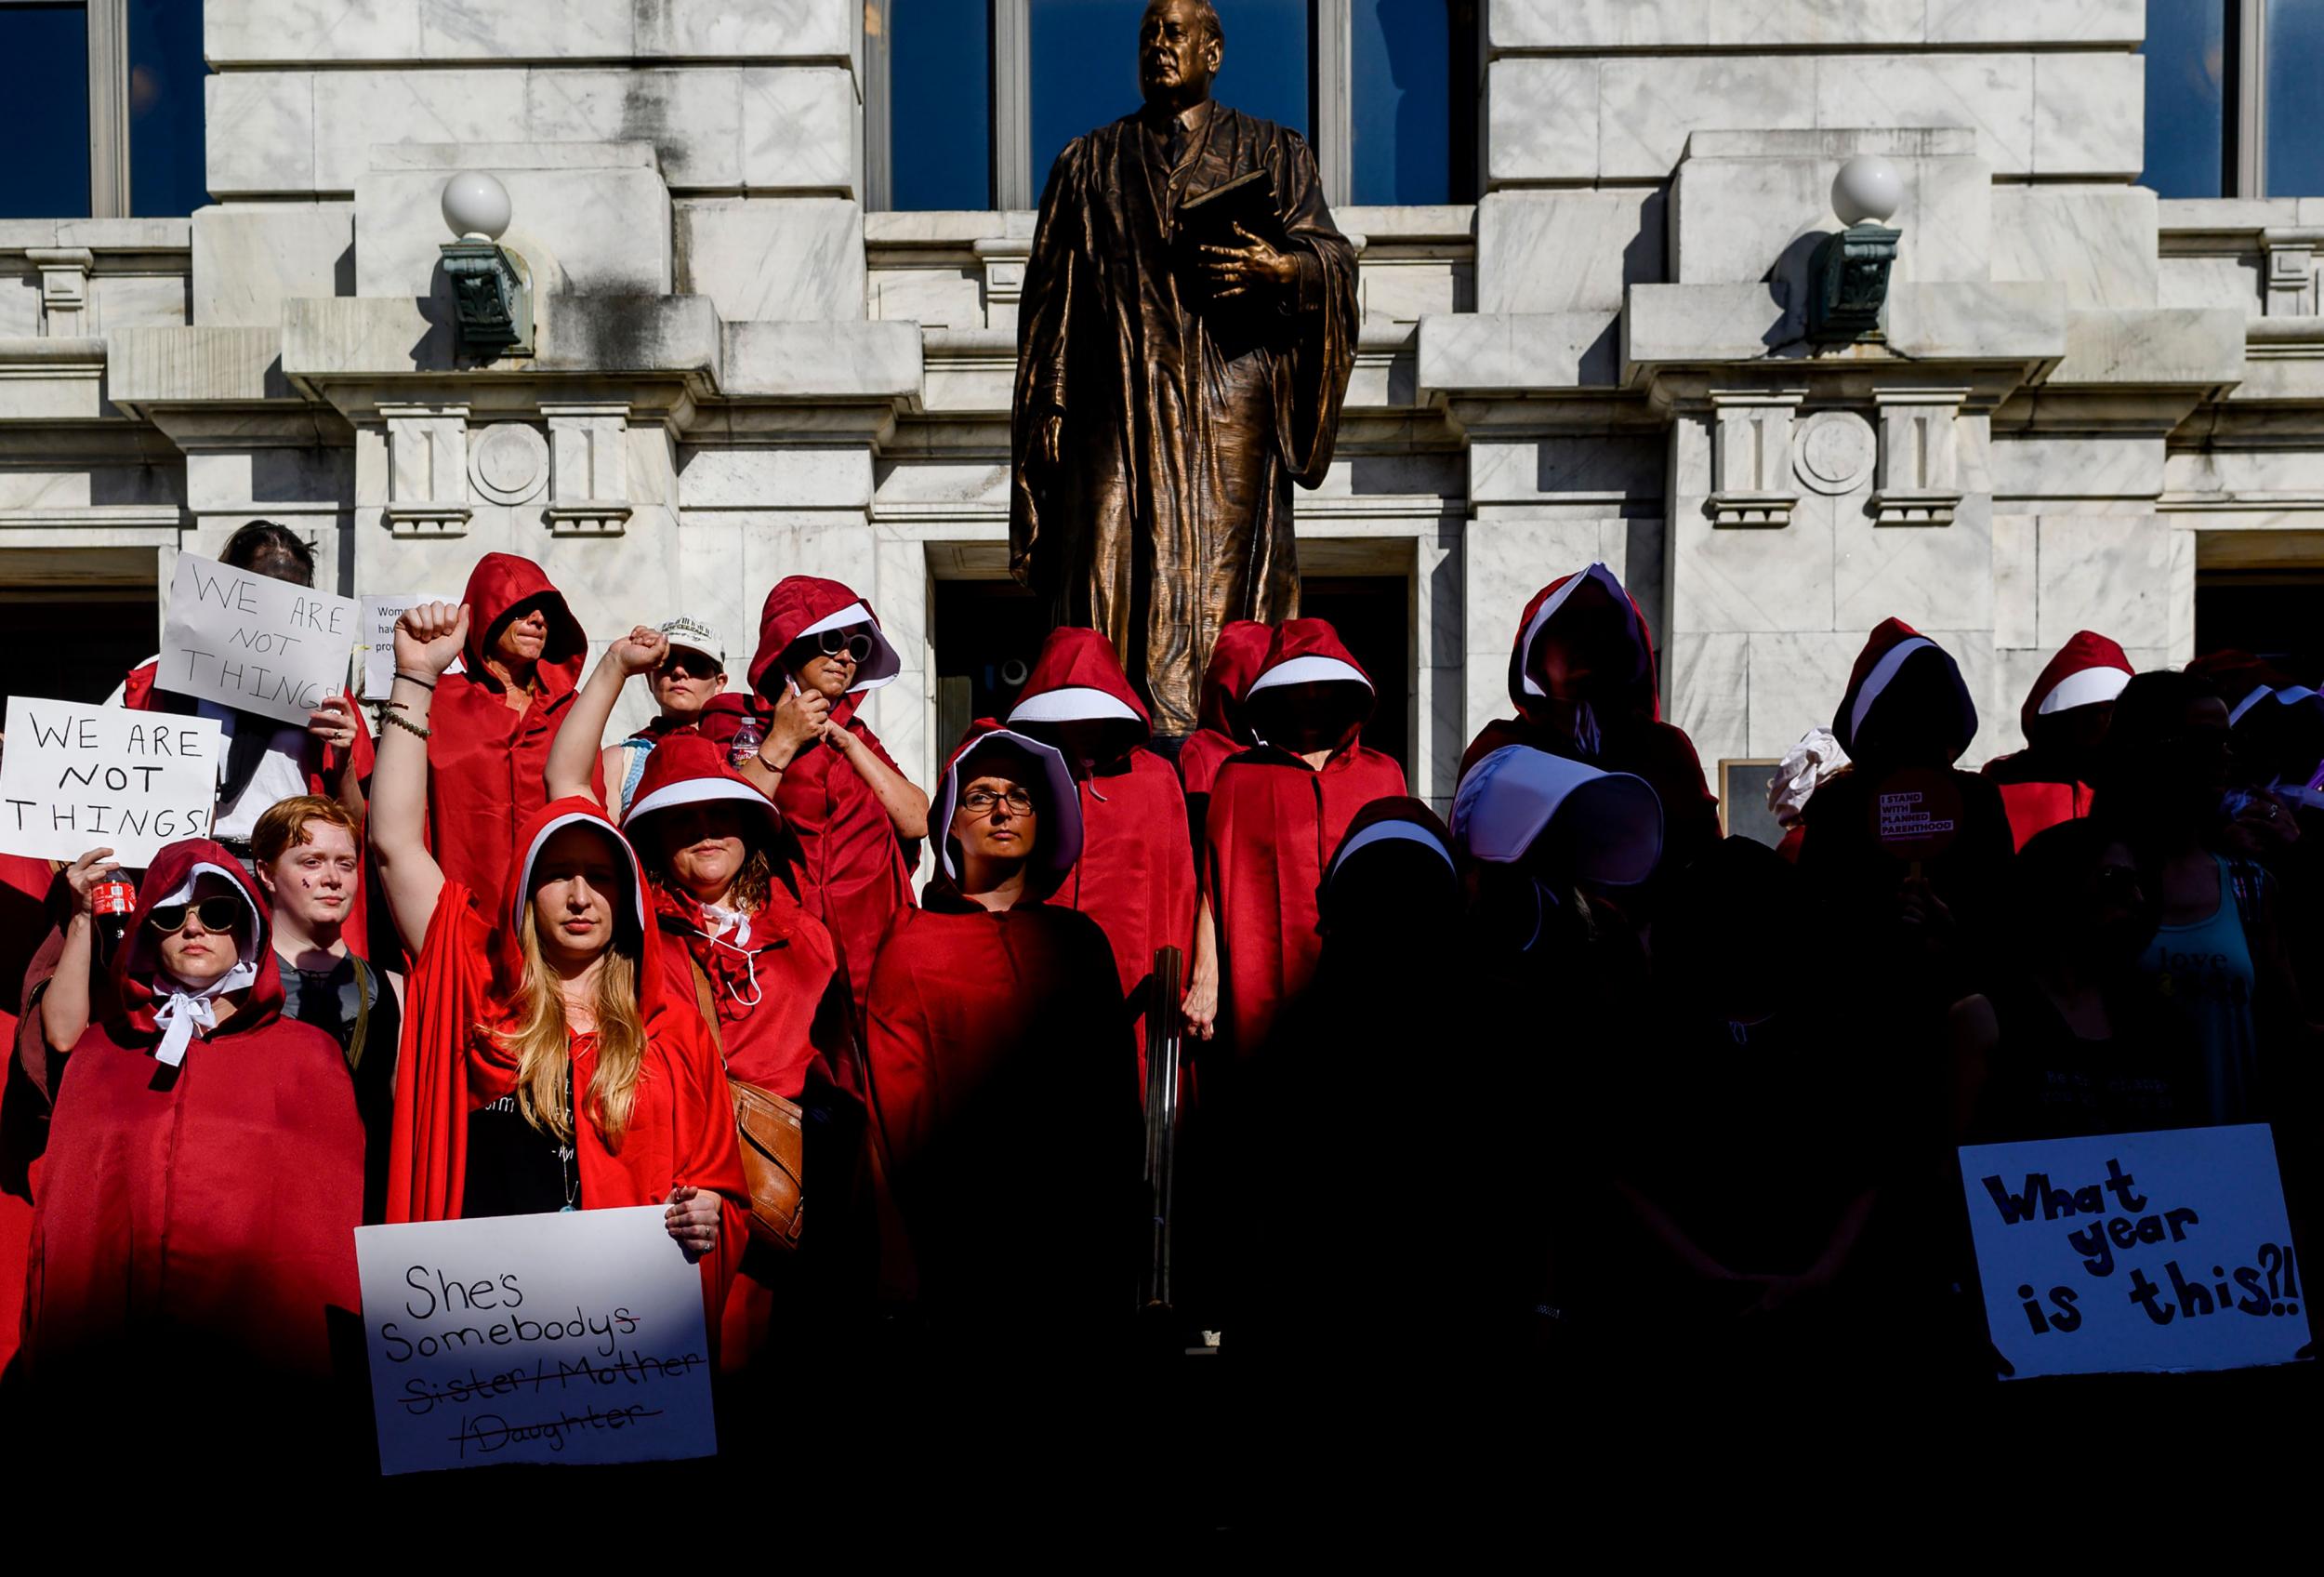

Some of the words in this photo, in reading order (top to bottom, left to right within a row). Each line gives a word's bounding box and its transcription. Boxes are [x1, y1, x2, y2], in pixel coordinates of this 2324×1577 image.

[192, 563, 257, 615] WE
[290, 596, 345, 636] ARE
[377, 606, 405, 616] Wom
[229, 628, 302, 656] NOT
[30, 712, 99, 749] WE
[127, 724, 203, 757] ARE
[59, 763, 164, 792] NOT
[1882, 804, 1909, 814] WITH
[1888, 793, 1921, 803] STAND
[6, 799, 210, 837] THINGS!
[1882, 814, 1929, 824] PLANNED
[1882, 822, 1952, 834] PARENTHOOD
[1981, 1158, 2148, 1226] What
[2067, 1207, 2199, 1278] year
[405, 1265, 524, 1319] She's
[2017, 1284, 2082, 1335] is
[2129, 1242, 2300, 1326] this?!
[380, 1305, 641, 1363] Somebodys
